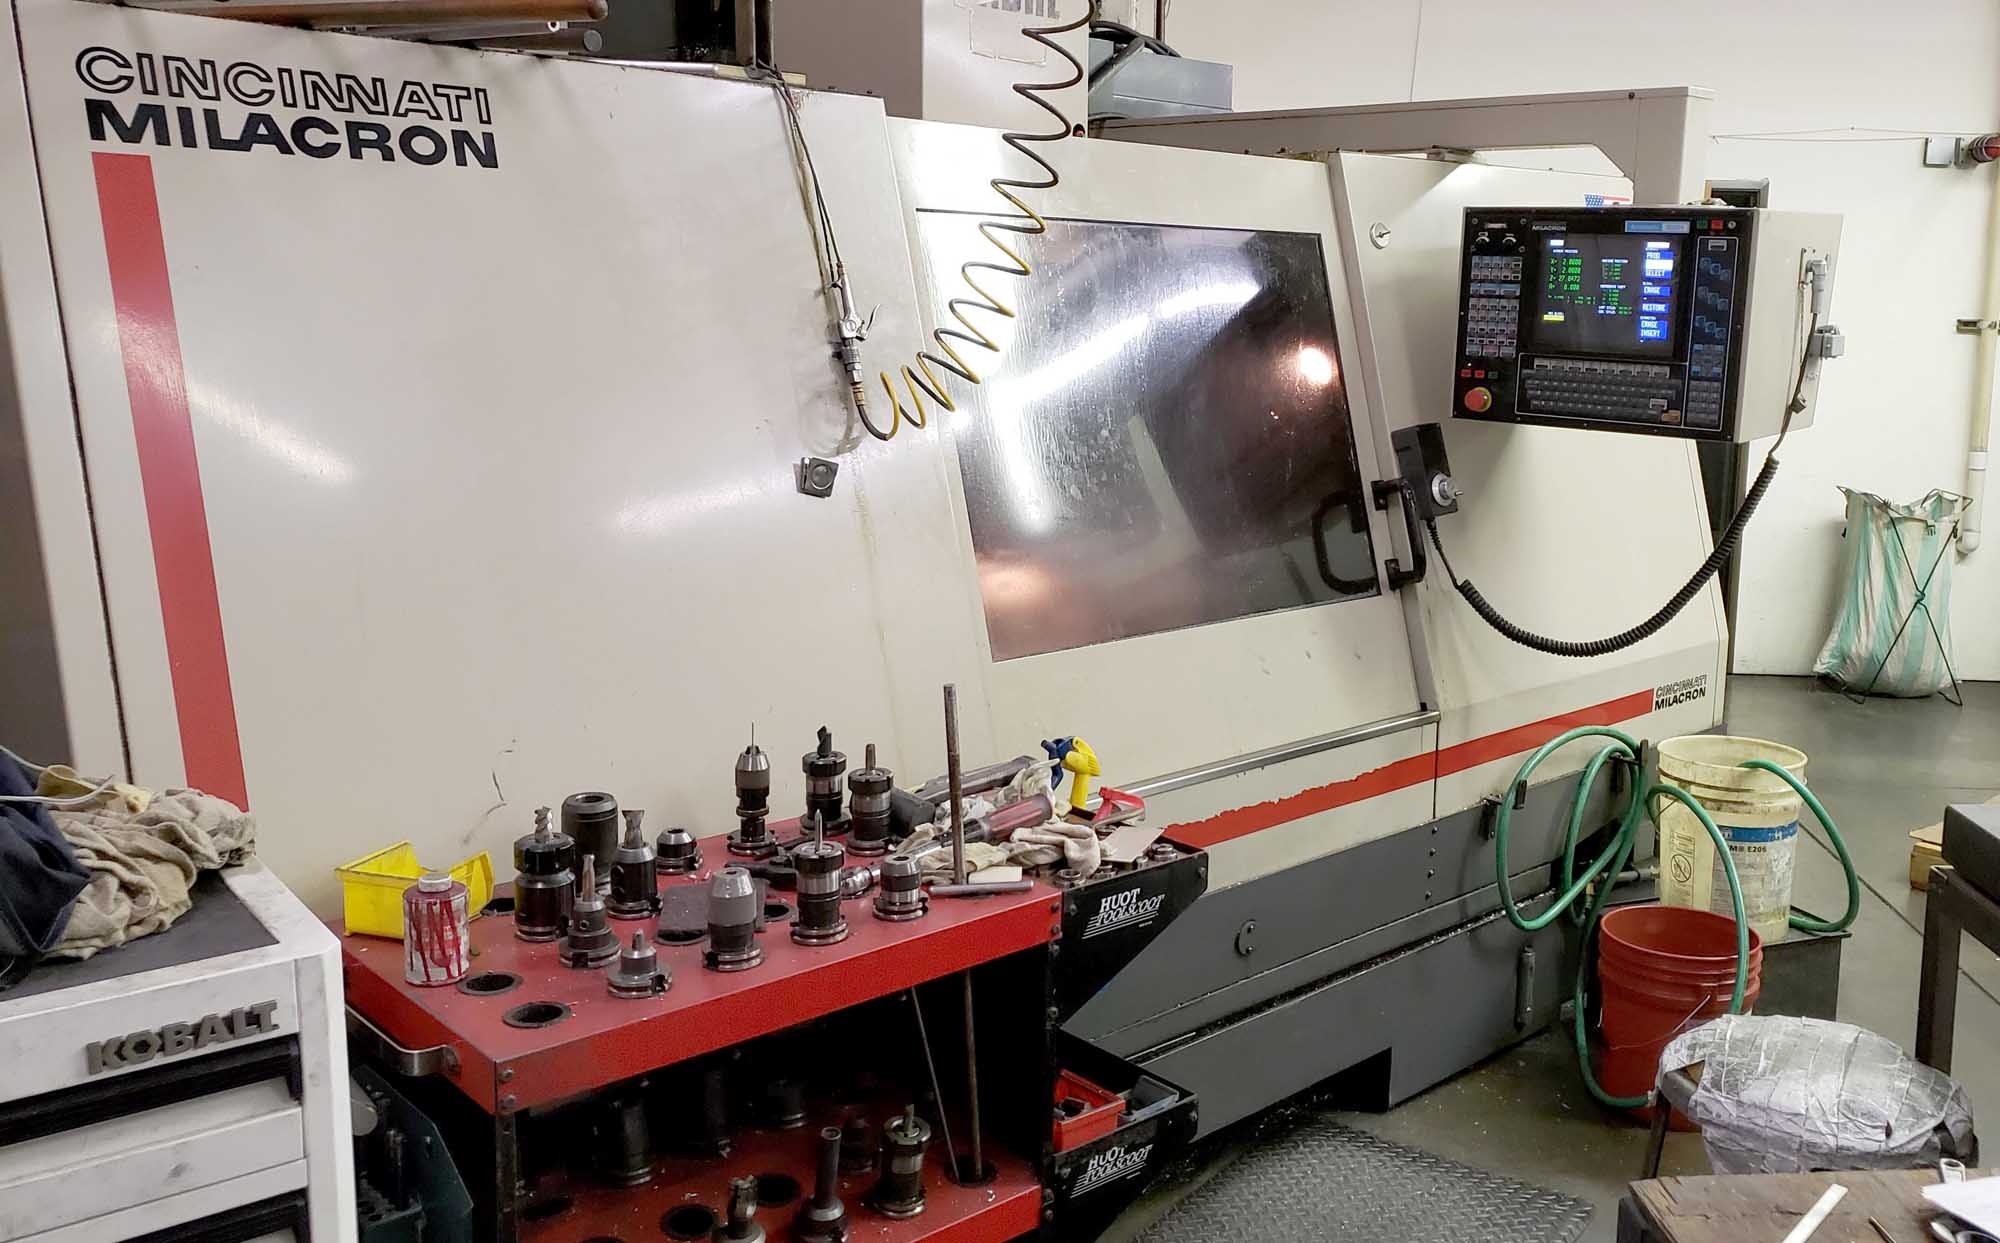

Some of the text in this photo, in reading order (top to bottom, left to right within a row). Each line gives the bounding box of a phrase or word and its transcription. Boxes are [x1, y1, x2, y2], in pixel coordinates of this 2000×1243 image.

[75, 46, 492, 124] CINCINNATI
[84, 98, 499, 168] MILACRON
[1655, 686, 1706, 711] MILACRON
[1656, 674, 1707, 699] CINCINNATI
[1099, 887, 1141, 914] HUOT
[87, 1000, 280, 1075] KOBALT
[1087, 1144, 1128, 1171] HUOT
